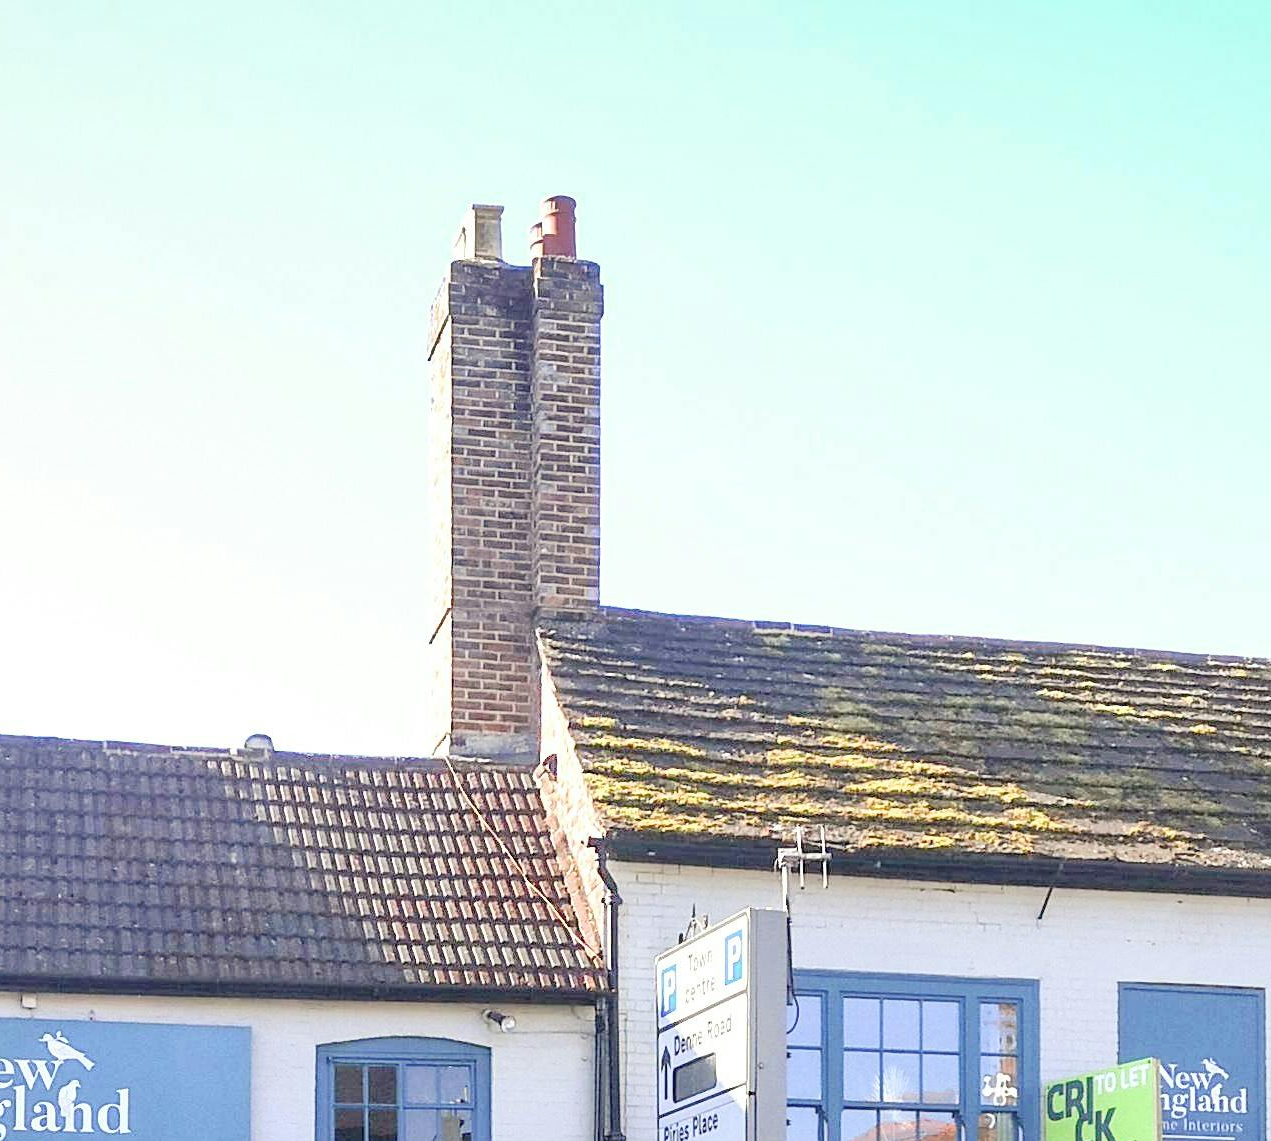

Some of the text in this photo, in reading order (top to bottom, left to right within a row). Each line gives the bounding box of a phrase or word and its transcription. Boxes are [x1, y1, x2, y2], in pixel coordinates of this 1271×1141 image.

[688, 950, 713, 972] Town
[685, 977, 716, 1003] centre
[674, 1014, 733, 1057] Denne Road
[1095, 1064, 1150, 1095] TO LET
[1158, 1063, 1215, 1090] New
[1047, 1076, 1093, 1124] CRI
[1159, 1085, 1249, 1119] ngland
[692, 1112, 719, 1138] Place
[1184, 1118, 1244, 1132] Interiors
